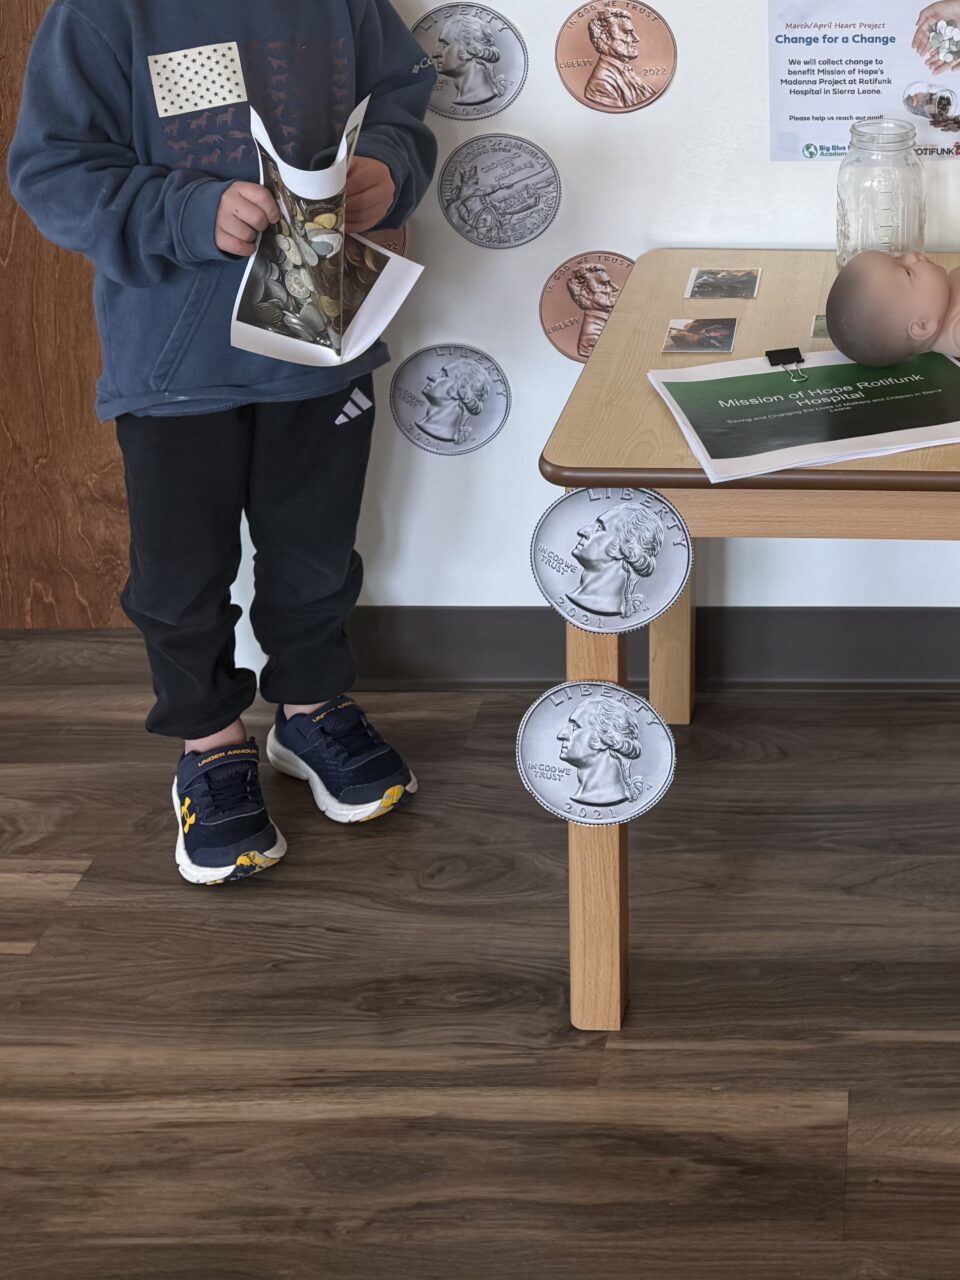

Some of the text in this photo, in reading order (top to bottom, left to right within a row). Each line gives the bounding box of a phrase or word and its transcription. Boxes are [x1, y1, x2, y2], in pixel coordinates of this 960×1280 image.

[859, 22, 885, 30] Project
[775, 34, 819, 45] Change
[822, 35, 839, 43] for
[852, 35, 896, 45] Change
[845, 58, 873, 67] change
[858, 68, 883, 77] Hope's
[819, 78, 846, 87] Project
[790, 88, 821, 96] Hospital
[718, 394, 784, 408] Mission
[808, 386, 854, 396] Hope
[856, 374, 924, 389] Rotifunk
[796, 391, 865, 407] Hospital
[586, 488, 687, 549] LIBERTY
[549, 684, 662, 728] LIBERTY
[563, 803, 617, 819] 2021
